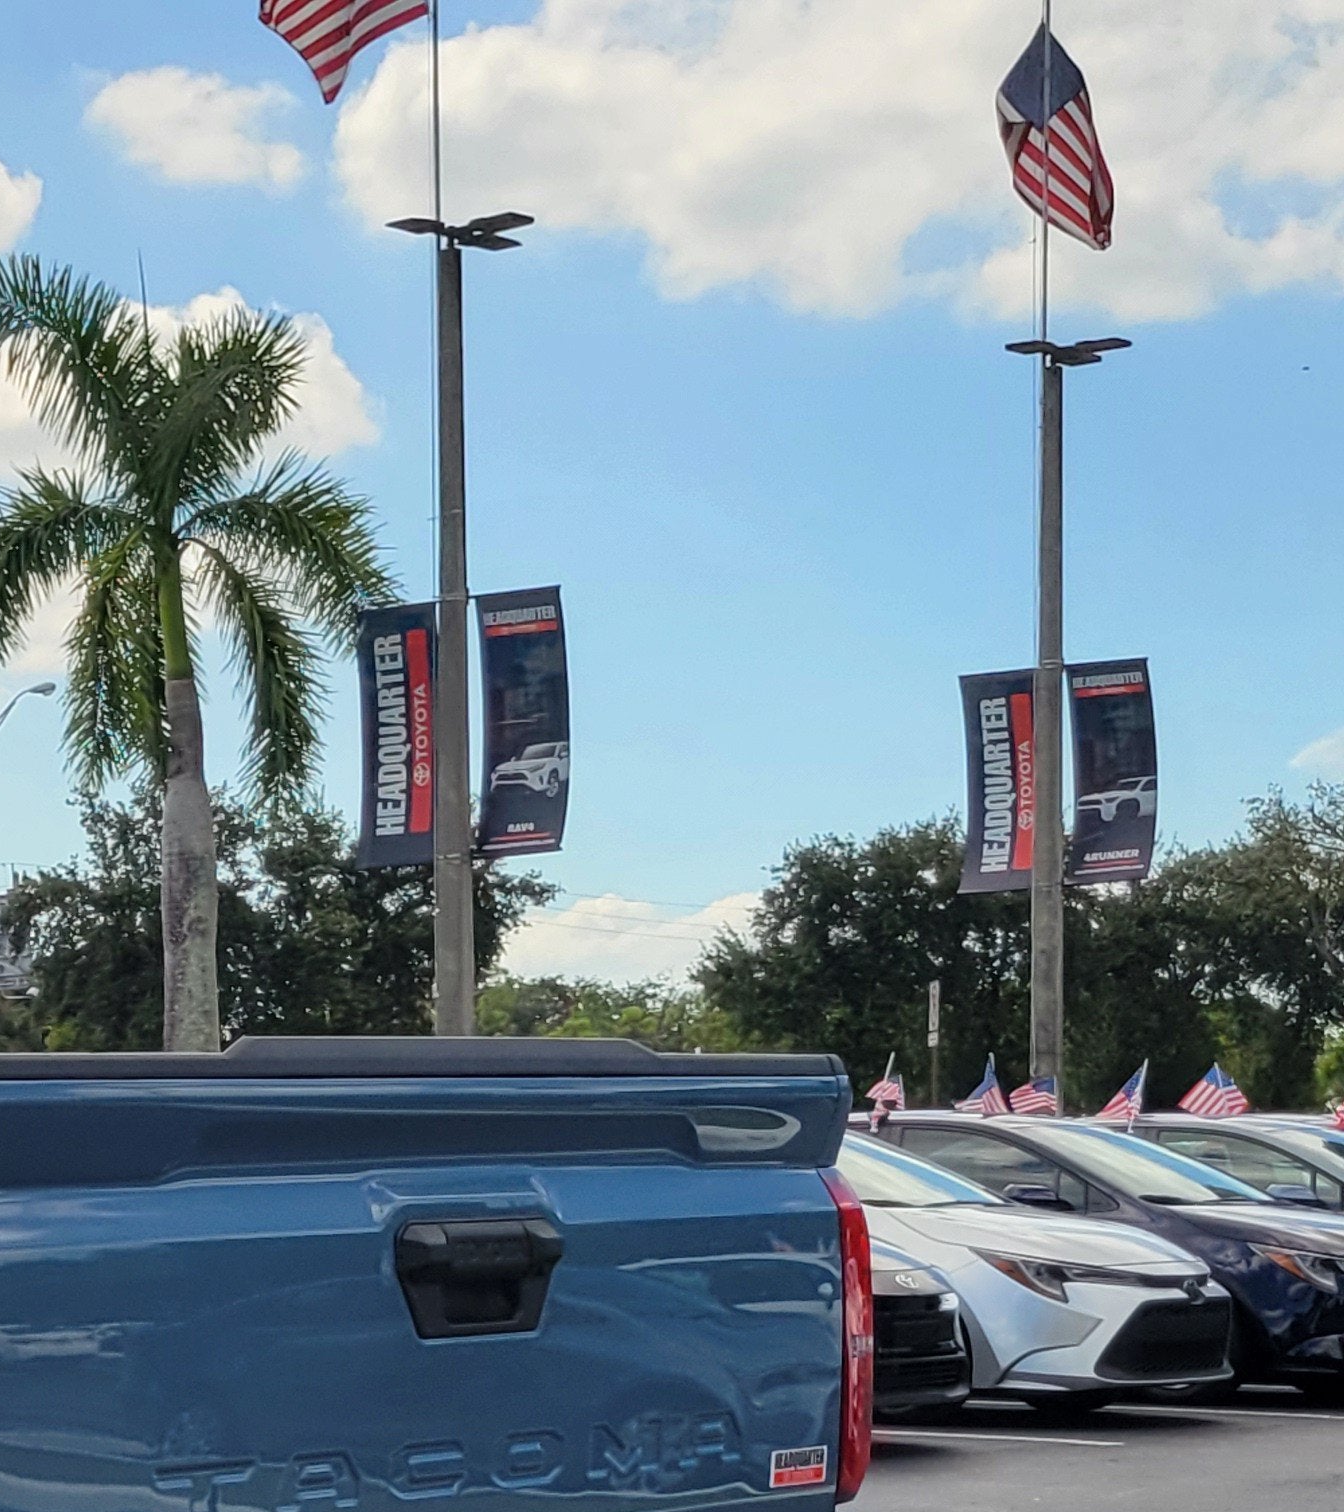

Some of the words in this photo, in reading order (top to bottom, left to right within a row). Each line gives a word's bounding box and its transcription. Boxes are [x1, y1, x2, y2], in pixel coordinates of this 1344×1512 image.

[373, 632, 412, 837] HEADQUARTER
[413, 683, 429, 761] TOYOTA
[979, 696, 1016, 874] HEADQUARTER
[1018, 740, 1032, 809] TOYOTA
